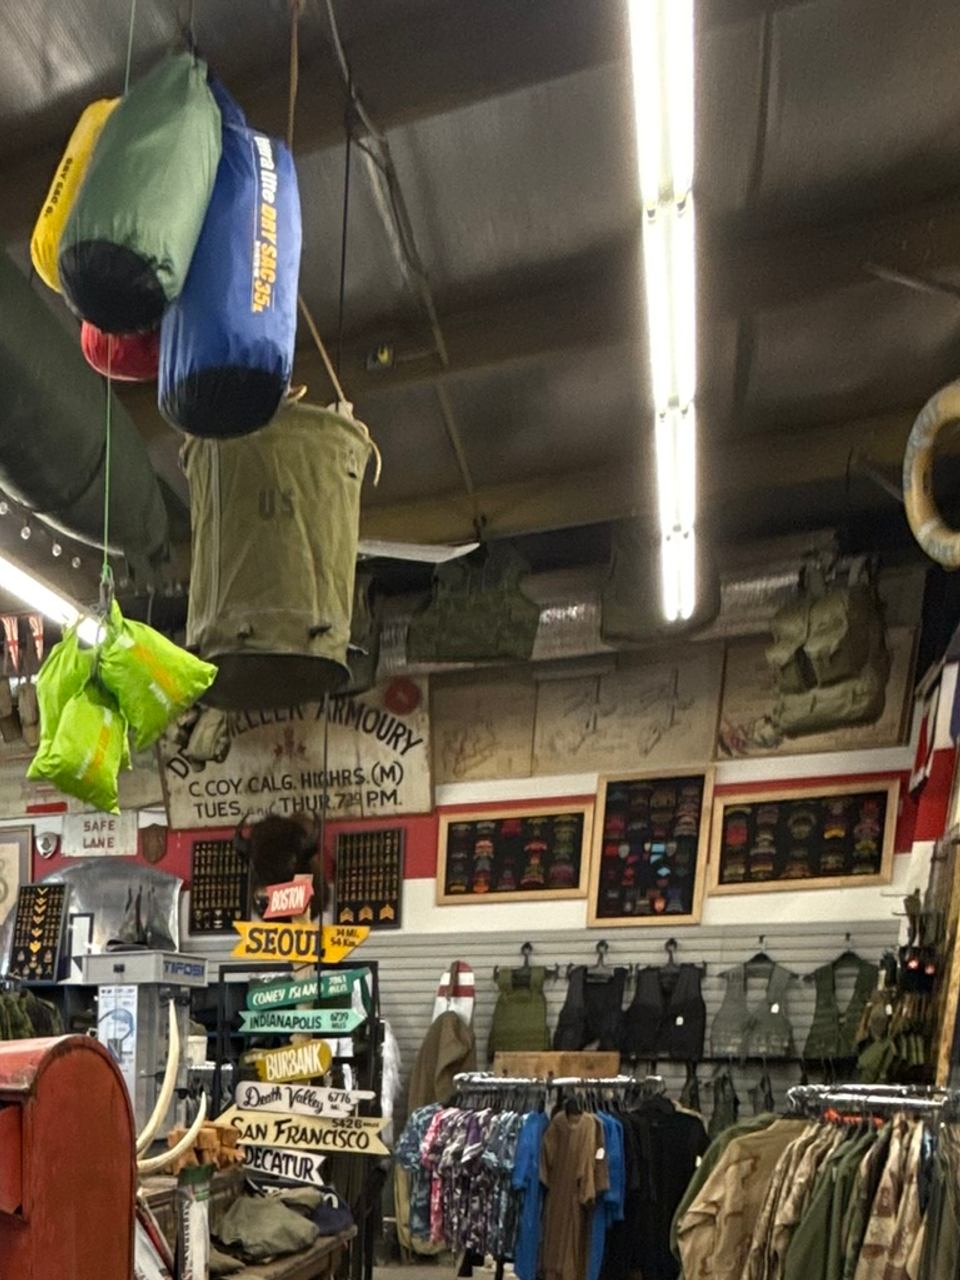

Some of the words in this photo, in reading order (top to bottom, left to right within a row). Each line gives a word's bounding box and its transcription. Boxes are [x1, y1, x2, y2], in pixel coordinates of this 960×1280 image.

[260, 203, 278, 243] DRY
[259, 242, 278, 283] SAC
[315, 694, 424, 756] ARMOURY
[371, 760, 404, 787] (M)
[83, 819, 116, 833] SAFE
[82, 836, 115, 849] LANE
[271, 884, 306, 913] BOSTON
[245, 927, 326, 958] SEOUL
[163, 960, 206, 977] TIFOSI
[252, 988, 286, 1006] CONEY
[249, 1012, 323, 1030] INDIANAPOLIS
[265, 1042, 323, 1080] BURBANK
[243, 1085, 283, 1108] Death
[285, 1086, 325, 1115] Valley
[230, 1116, 268, 1141] SAN
[272, 1117, 370, 1150] FRANCISCO
[245, 1146, 315, 1182] DECATUR
